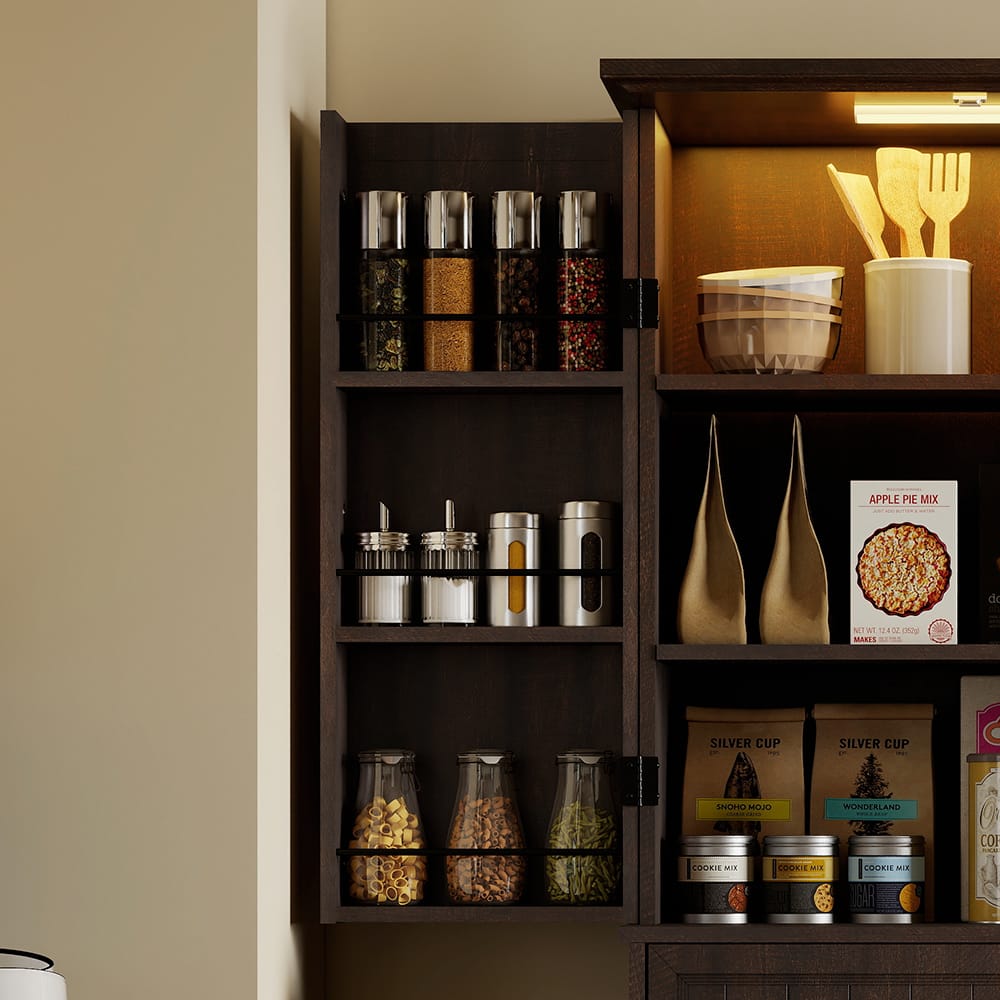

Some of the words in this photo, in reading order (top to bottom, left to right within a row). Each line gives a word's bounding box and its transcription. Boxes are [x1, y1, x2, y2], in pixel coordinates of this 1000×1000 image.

[869, 494, 900, 504] APPLE
[902, 494, 917, 504] PIE
[920, 494, 939, 504] MIX
[710, 738, 751, 748] SILVER
[756, 738, 781, 748] CUP
[839, 738, 880, 749] SILVER
[884, 738, 910, 749] CUP
[692, 864, 722, 872] COOKIE
[724, 864, 738, 872] MIX
[778, 864, 808, 872] COOKIE
[809, 864, 824, 872] MIX
[864, 864, 894, 872] COOKIE
[895, 864, 910, 872] MIX
